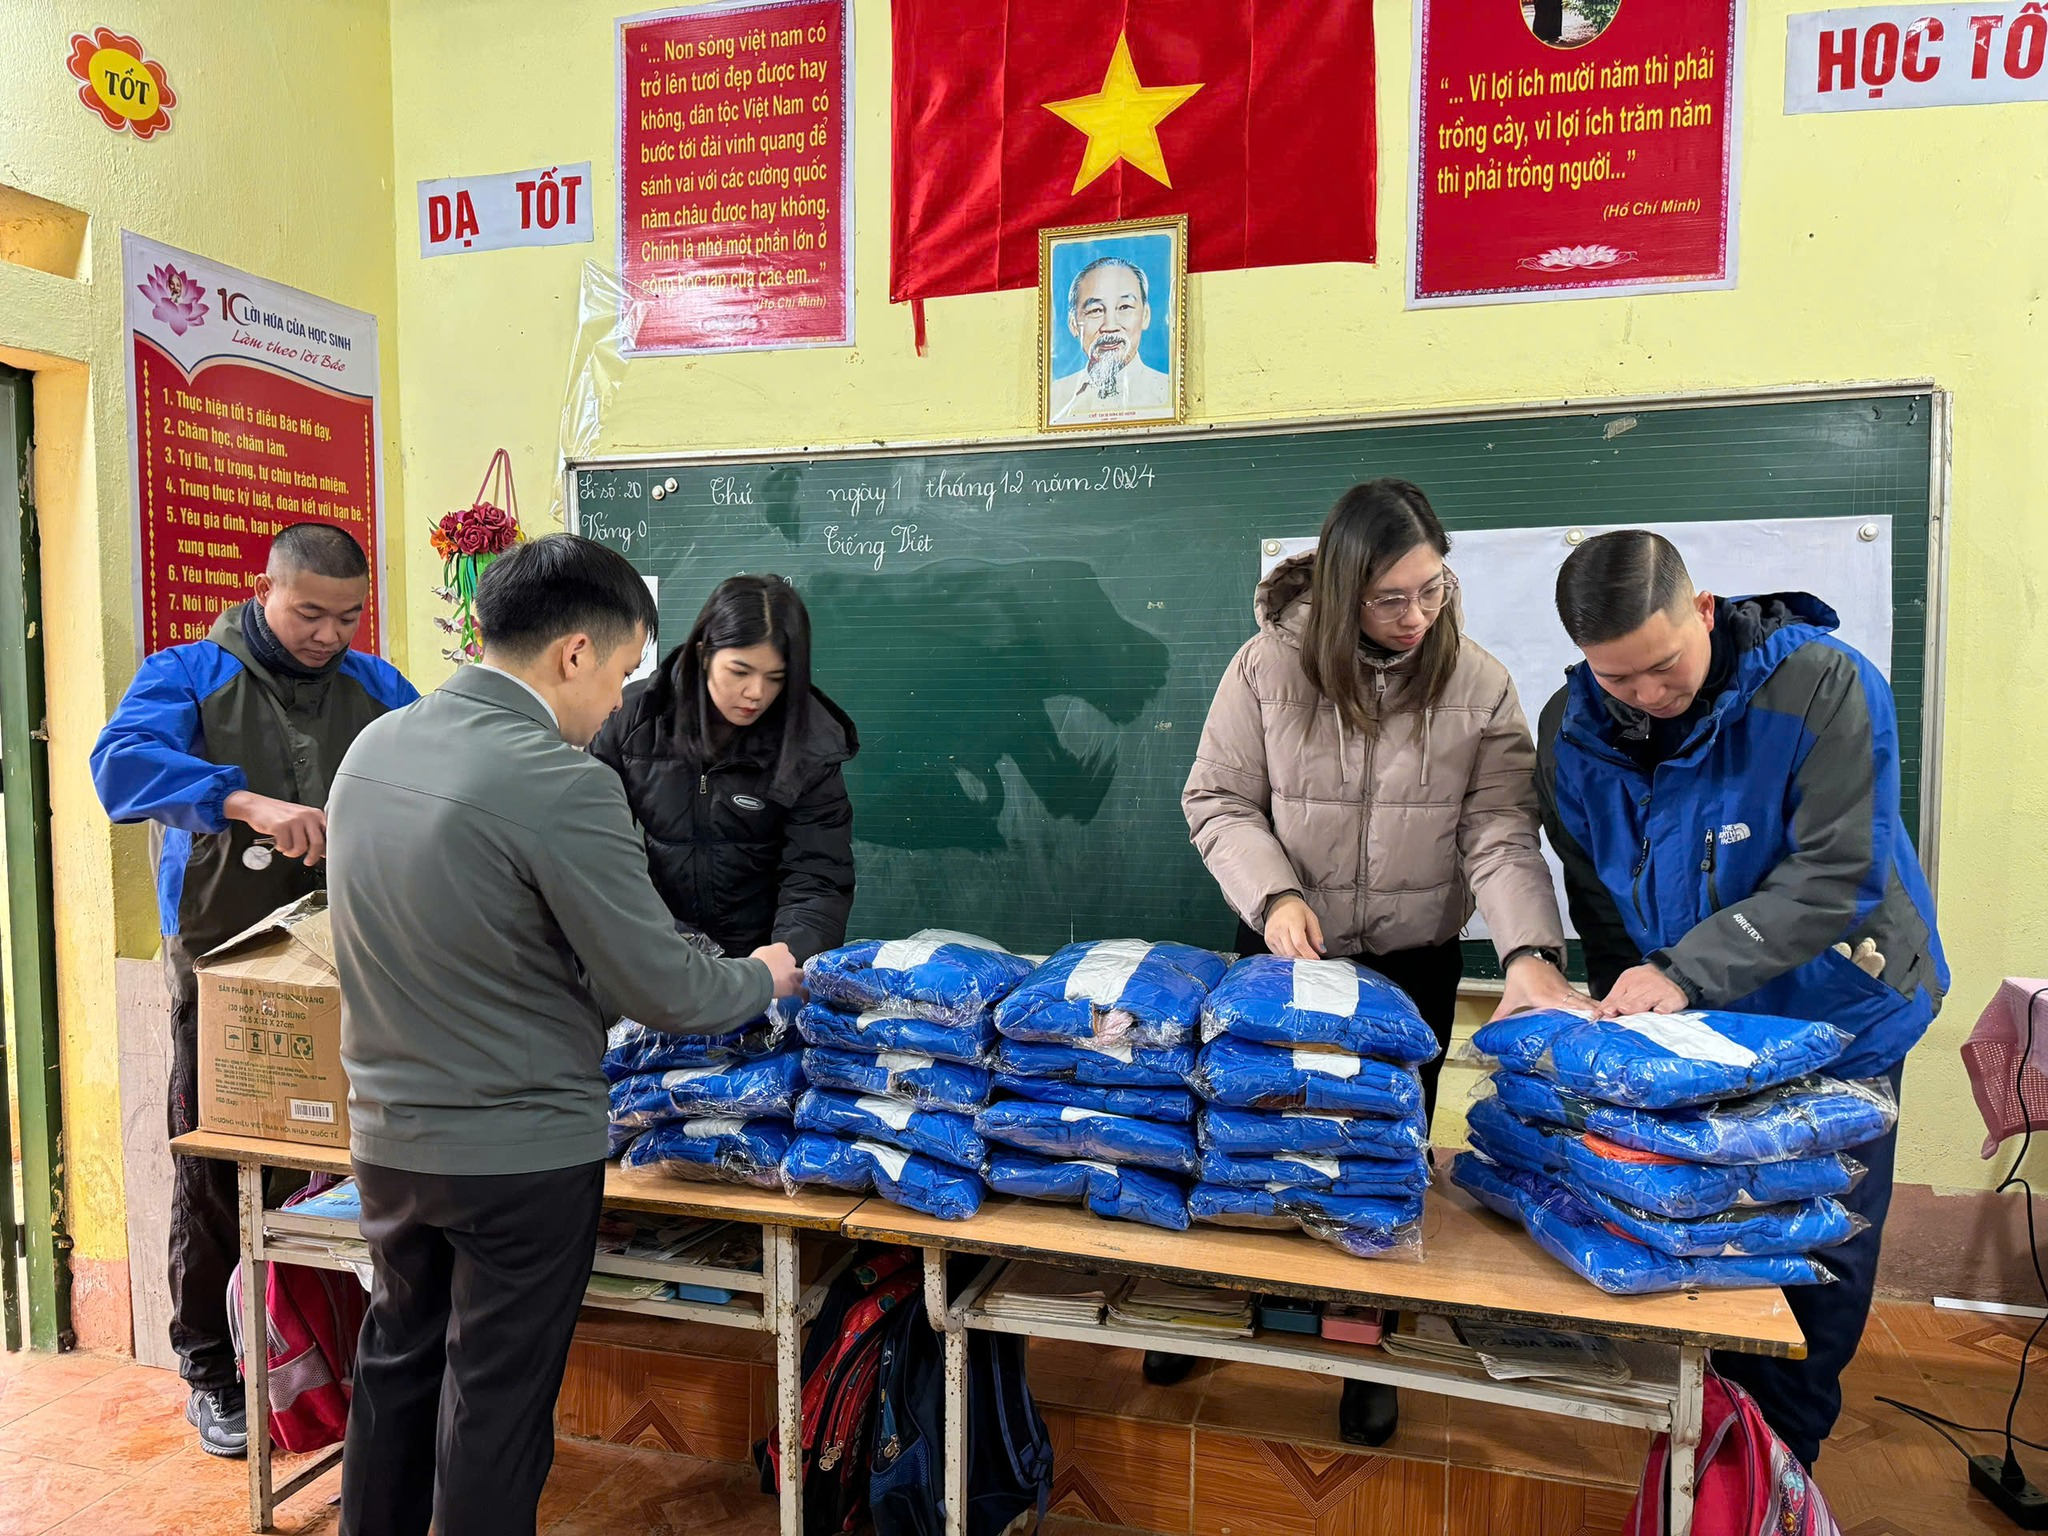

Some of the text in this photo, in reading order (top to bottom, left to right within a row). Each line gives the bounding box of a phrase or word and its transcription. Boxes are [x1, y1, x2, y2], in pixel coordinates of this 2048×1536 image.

[665, 20, 826, 61] Non sông việt nam có
[1818, 16, 1944, 99] HỌC
[104, 67, 150, 105] TỐT
[641, 58, 827, 98] trở lên tươi đẹp được hay
[1469, 46, 1714, 107] Vì lợi ích mười năm thì phải
[641, 89, 829, 133] không, dân tộc Việt Nam có
[1439, 98, 1712, 154] trồng cây, vì lợi ích trăm năm
[641, 117, 827, 164] bước tới đài vinh quang để
[641, 155, 827, 196] sánh vai với các cường quốc
[1437, 153, 1553, 198] thì phải trồng
[429, 166, 582, 248] DẠ TỐT
[641, 195, 829, 229] năm châu được hay không.
[1603, 197, 1701, 221] (Hồ Chí Minh)
[641, 222, 827, 262] Chính là nhờ một phần lớn ở
[758, 266, 783, 286] các
[244, 304, 260, 325] LỜI
[263, 309, 284, 331] HỨA
[286, 316, 306, 338] CỦA
[308, 324, 327, 346] HỌC
[329, 331, 351, 351] SINH
[231, 329, 346, 373] Làm theo lời Bác
[163, 388, 332, 442] 1. Thực hiện tốt 5 điều Bác Hồ dạy.
[164, 418, 288, 458] 2. Chăm học, chăm làm.
[165, 447, 349, 494] 3. Tự tin, tự trọng, tự chịu trách nhiệm.
[624, 481, 642, 498] 20
[166, 477, 364, 522] 4. Trung thực kỷ luật, đoàn kết với bạn bè.
[710, 477, 754, 505] Thứ
[827, 482, 886, 516] ngày
[891, 477, 902, 500] 1
[925, 469, 998, 512] tháng
[1000, 470, 1023, 493] 12
[1031, 473, 1092, 492] năm
[166, 506, 177, 523] 5.
[180, 507, 200, 526] Yêu
[203, 511, 220, 530] gia
[223, 512, 248, 533] đình,
[251, 515, 268, 536] bạn
[178, 538, 242, 561] xung quanh.
[824, 524, 933, 571] Tiếng Việt
[168, 564, 241, 588] 6. Yêu trường,
[169, 594, 218, 612] 7. Nói lời
[170, 623, 180, 639] 8.
